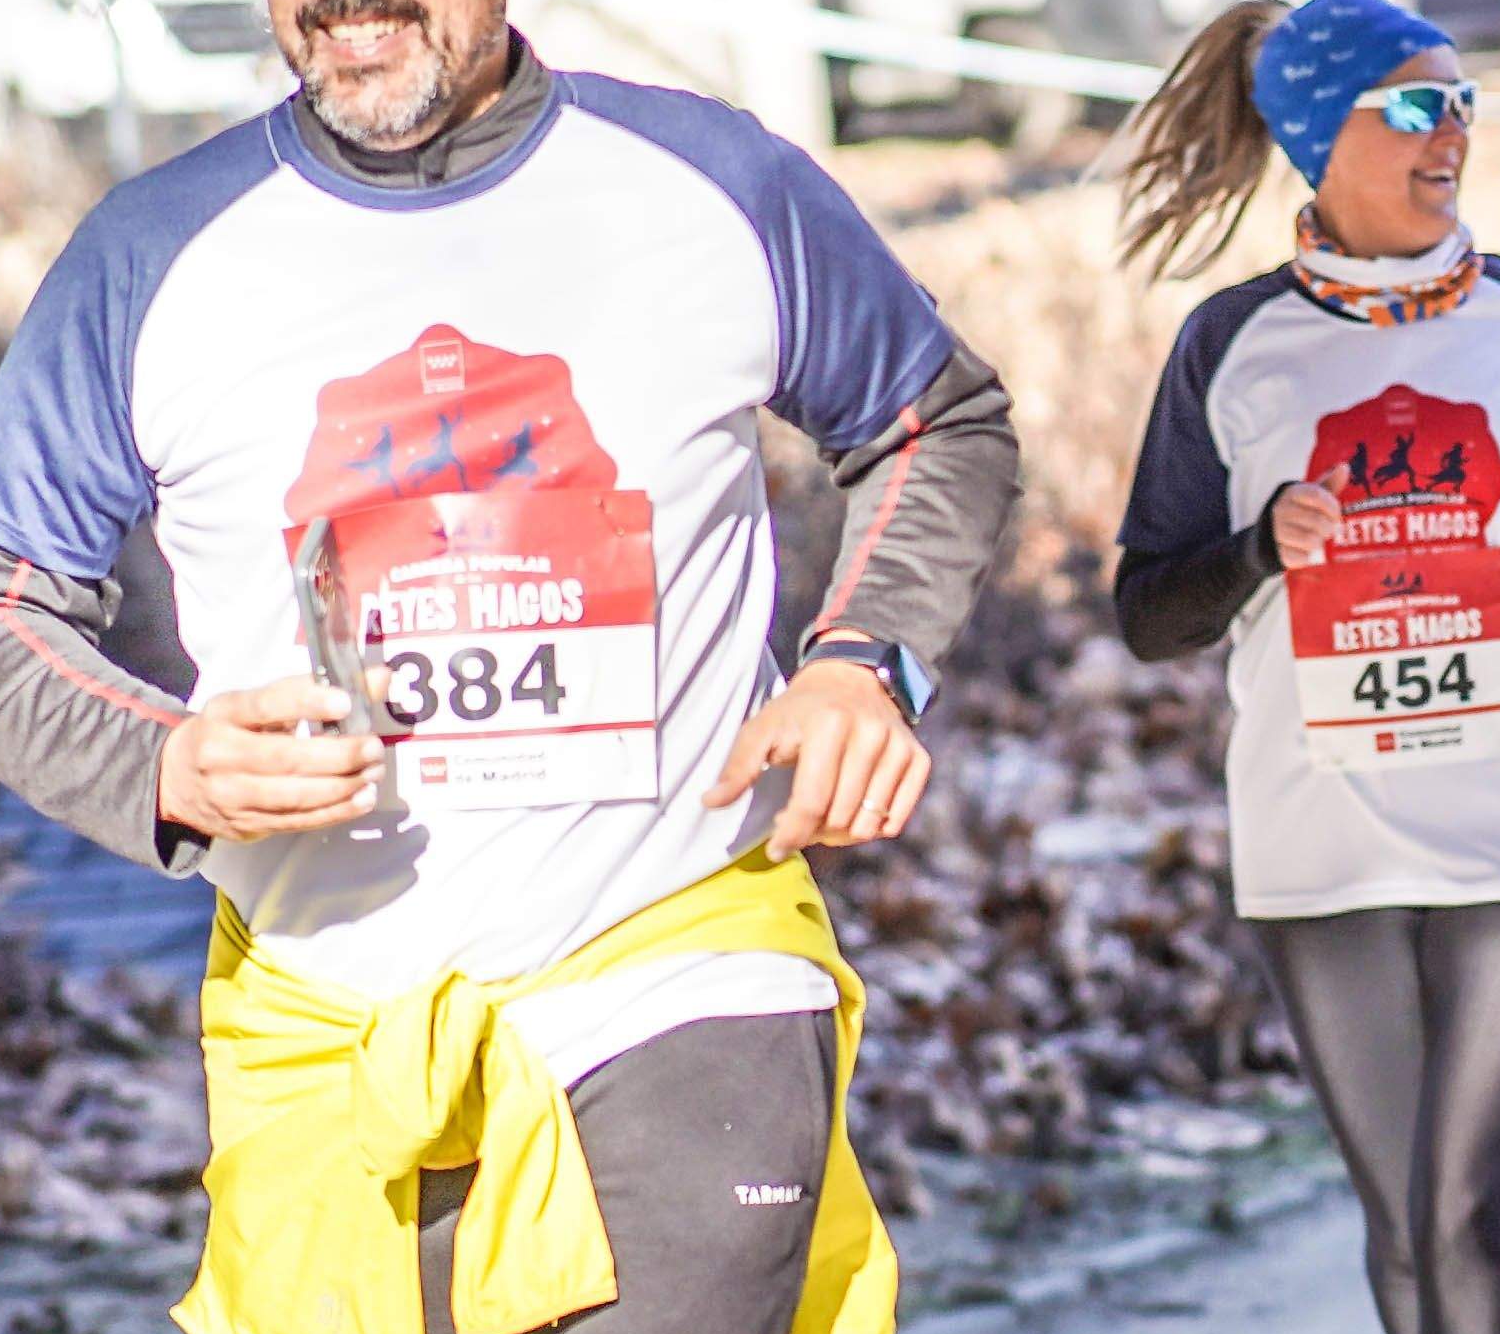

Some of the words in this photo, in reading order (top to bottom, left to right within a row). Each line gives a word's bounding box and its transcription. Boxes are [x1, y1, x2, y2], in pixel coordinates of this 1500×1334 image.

[1406, 511, 1480, 542] MAGOS
[359, 586, 457, 634] REYES
[468, 578, 584, 630] MAGOS
[1332, 619, 1400, 651] REYES
[1406, 608, 1483, 646] MAGOS
[384, 643, 566, 723] 384
[1353, 652, 1476, 712] 454
